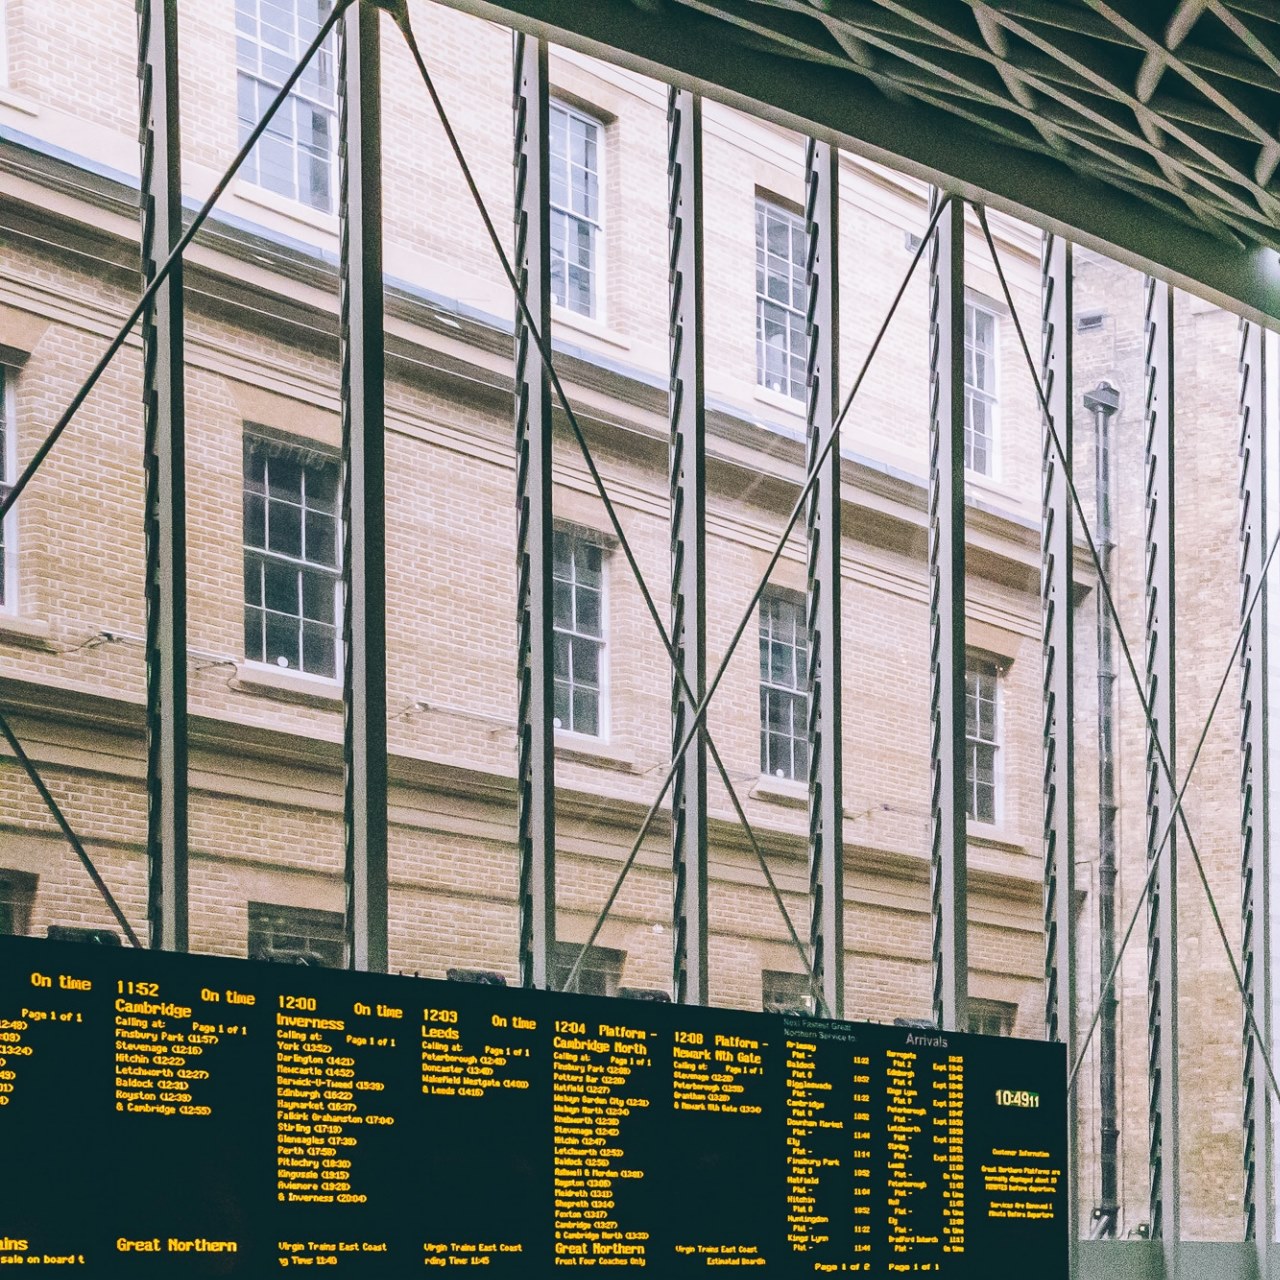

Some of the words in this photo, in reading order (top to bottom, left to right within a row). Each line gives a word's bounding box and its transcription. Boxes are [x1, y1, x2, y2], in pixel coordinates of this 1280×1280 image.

[31, 972, 51, 988] On
[59, 974, 92, 991] time
[117, 980, 159, 997] 11:52
[201, 988, 220, 1002] On
[226, 989, 256, 1006] time
[278, 995, 317, 1011] 12:00
[115, 998, 192, 1018] Cambridge
[353, 1002, 372, 1016] On
[376, 1004, 403, 1019] time
[21, 1008, 47, 1021] Page
[50, 1010, 57, 1020] 1
[60, 1012, 73, 1022] of
[76, 1013, 83, 1023] 1
[276, 1012, 345, 1031] Inverness
[423, 1008, 458, 1023] 12:03
[492, 1014, 507, 1028] On
[512, 1016, 537, 1030] time
[115, 1016, 149, 1030] Calling
[192, 1021, 216, 1035] Page
[218, 1024, 225, 1034] 1
[227, 1025, 239, 1034] of
[242, 1026, 248, 1036] 1
[554, 1020, 586, 1035] 12:04
[598, 1024, 646, 1040] Platform
[115, 1029, 158, 1042] Finsbury
[161, 1031, 184, 1043] Park
[276, 1029, 307, 1042] Calling
[421, 1024, 459, 1040] Leeds
[276, 1041, 300, 1051] York
[346, 1034, 367, 1046] Page
[421, 1040, 449, 1053] Calling
[553, 1036, 610, 1053] Cambridge
[614, 1041, 648, 1056] North
[715, 1034, 759, 1049] Platform
[906, 1033, 949, 1048] Arrivals
[115, 1041, 168, 1054] Stevenage
[115, 1053, 149, 1064] Hitchin
[276, 1052, 323, 1066] Darlington
[421, 1051, 478, 1066] Peterborough
[673, 1046, 712, 1061] Newark
[714, 1049, 734, 1062] Nth
[737, 1052, 761, 1064] Gate
[115, 1065, 173, 1078] Letchworth
[276, 1064, 323, 1076] Newcastle
[115, 1078, 153, 1088] Baldock
[115, 1090, 156, 1102] Royston
[276, 1087, 321, 1100] Edinburgh
[115, 1103, 124, 1112] &
[127, 1103, 176, 1116] Cambridge
[277, 1099, 325, 1111] Haymarket
[277, 1146, 304, 1156] Perth
[117, 1237, 161, 1251] Great
[168, 1238, 238, 1252] Northern
[278, 1242, 305, 1253] Virgin
[308, 1242, 336, 1252] Trains
[338, 1242, 360, 1252] East
[362, 1242, 388, 1252] Coast
[554, 1242, 588, 1255] Great
[593, 1242, 646, 1255] Northern
[1, 1255, 23, 1265] sale
[27, 1256, 40, 1265] on
[43, 1254, 75, 1265] board
[814, 1262, 838, 1273] Page
[888, 1262, 910, 1273] Page
